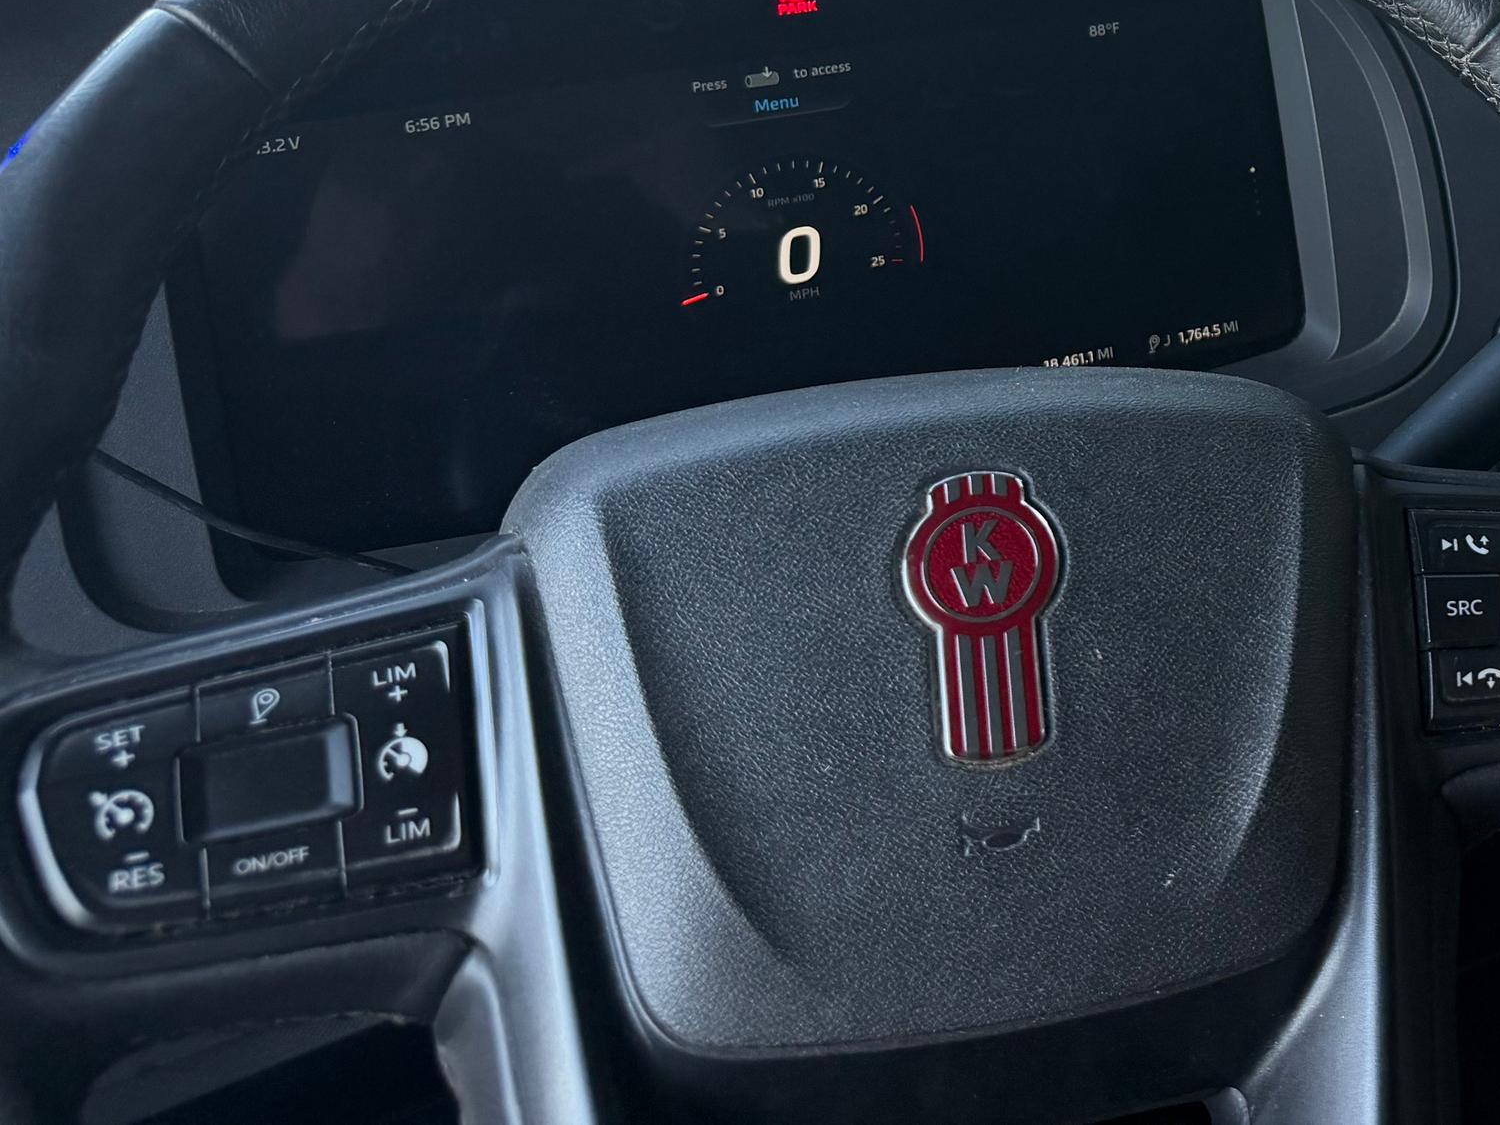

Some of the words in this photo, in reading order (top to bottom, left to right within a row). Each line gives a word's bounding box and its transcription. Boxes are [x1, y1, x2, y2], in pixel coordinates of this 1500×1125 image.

[778, 0, 818, 16] PARK
[692, 78, 728, 93] Press
[793, 68, 808, 79] to
[811, 61, 852, 77] access
[754, 95, 800, 113] Menu
[404, 116, 441, 134] 6:56
[444, 112, 472, 128] PM
[256, 138, 287, 155] 3.2
[750, 187, 764, 199] 10
[813, 177, 826, 189] 15
[767, 195, 790, 208] RPM
[853, 203, 868, 216] 20
[718, 228, 727, 239] 5
[778, 225, 821, 285] 0
[870, 255, 886, 268] 25
[716, 285, 725, 296] 0
[789, 286, 821, 302] MPH
[1177, 323, 1222, 346] 1,764.5
[1223, 319, 1239, 335] MI
[1043, 350, 1094, 368] 18461.1
[1098, 346, 1114, 361] MI
[960, 518, 1001, 566] K
[949, 561, 1015, 609] W
[1446, 598, 1484, 617] SRC
[371, 662, 418, 687] LIM
[93, 724, 146, 752] SET
[384, 818, 431, 845] LIM
[232, 845, 311, 875] ON/OFF
[108, 861, 166, 894] RES
